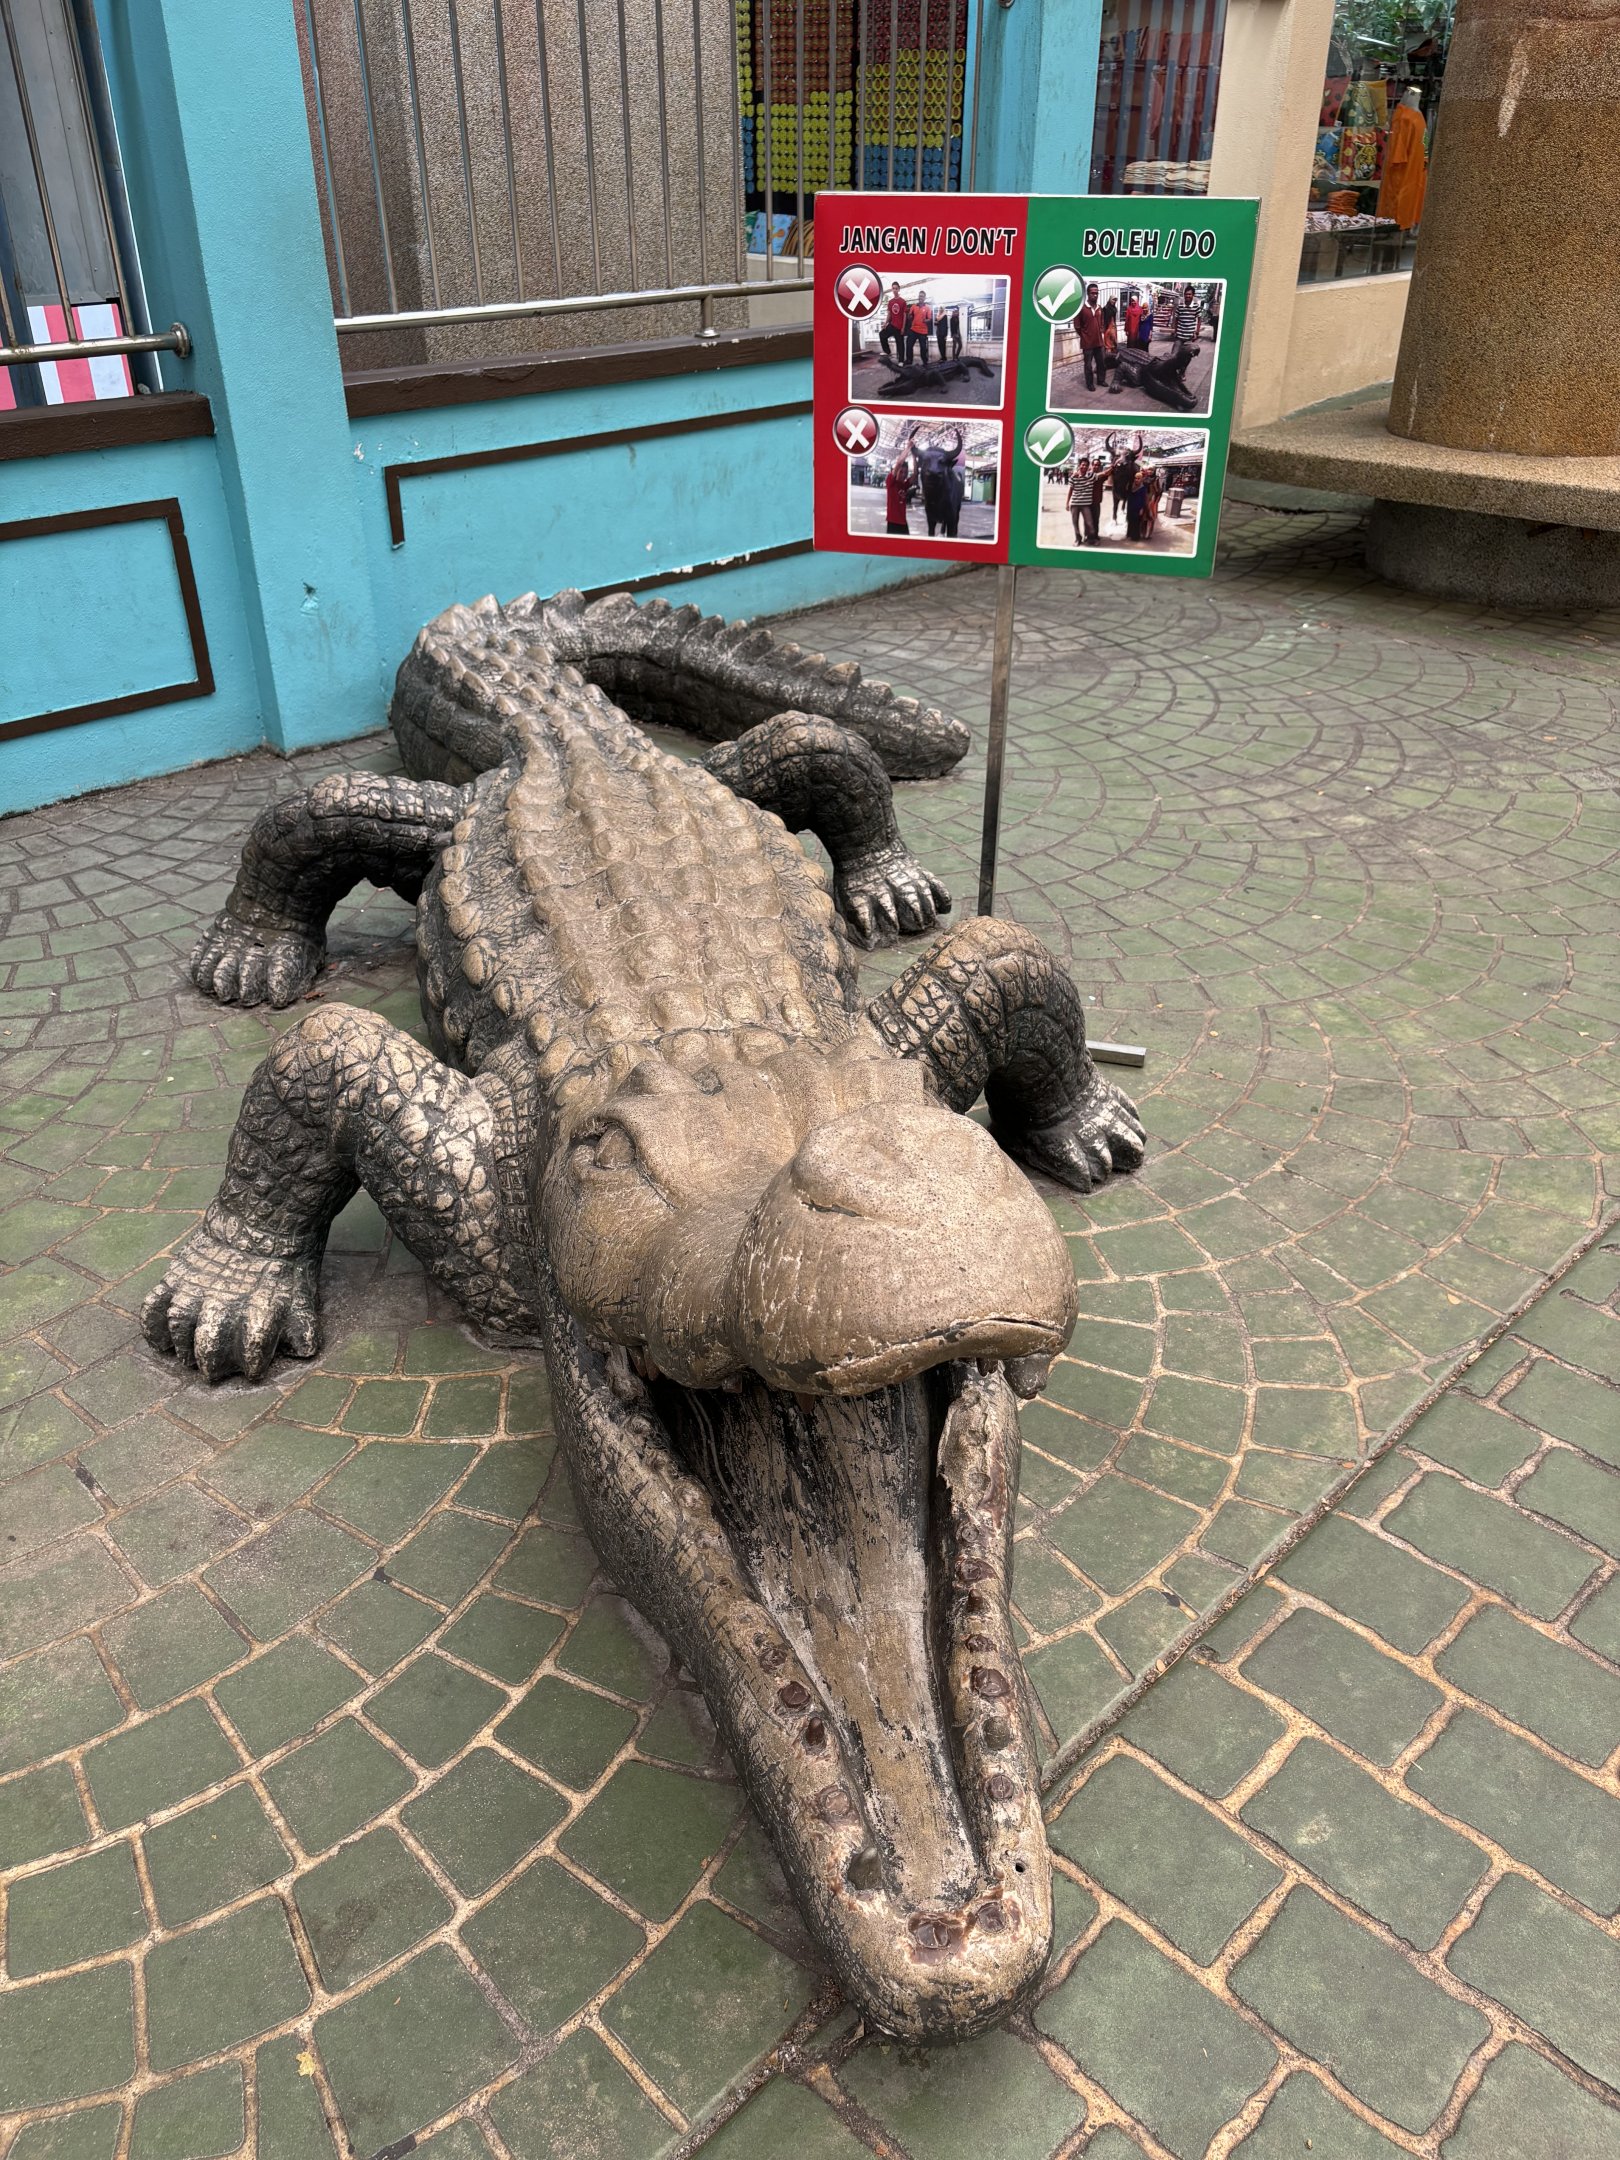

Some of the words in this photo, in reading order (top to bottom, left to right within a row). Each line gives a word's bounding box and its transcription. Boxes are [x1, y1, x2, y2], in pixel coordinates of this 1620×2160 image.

[839, 226, 927, 254] JANGAN
[931, 227, 942, 256] /
[945, 227, 1018, 256] DON'T
[1083, 228, 1160, 258] BOLEH
[1163, 229, 1177, 259] /
[1179, 229, 1217, 259] DO
